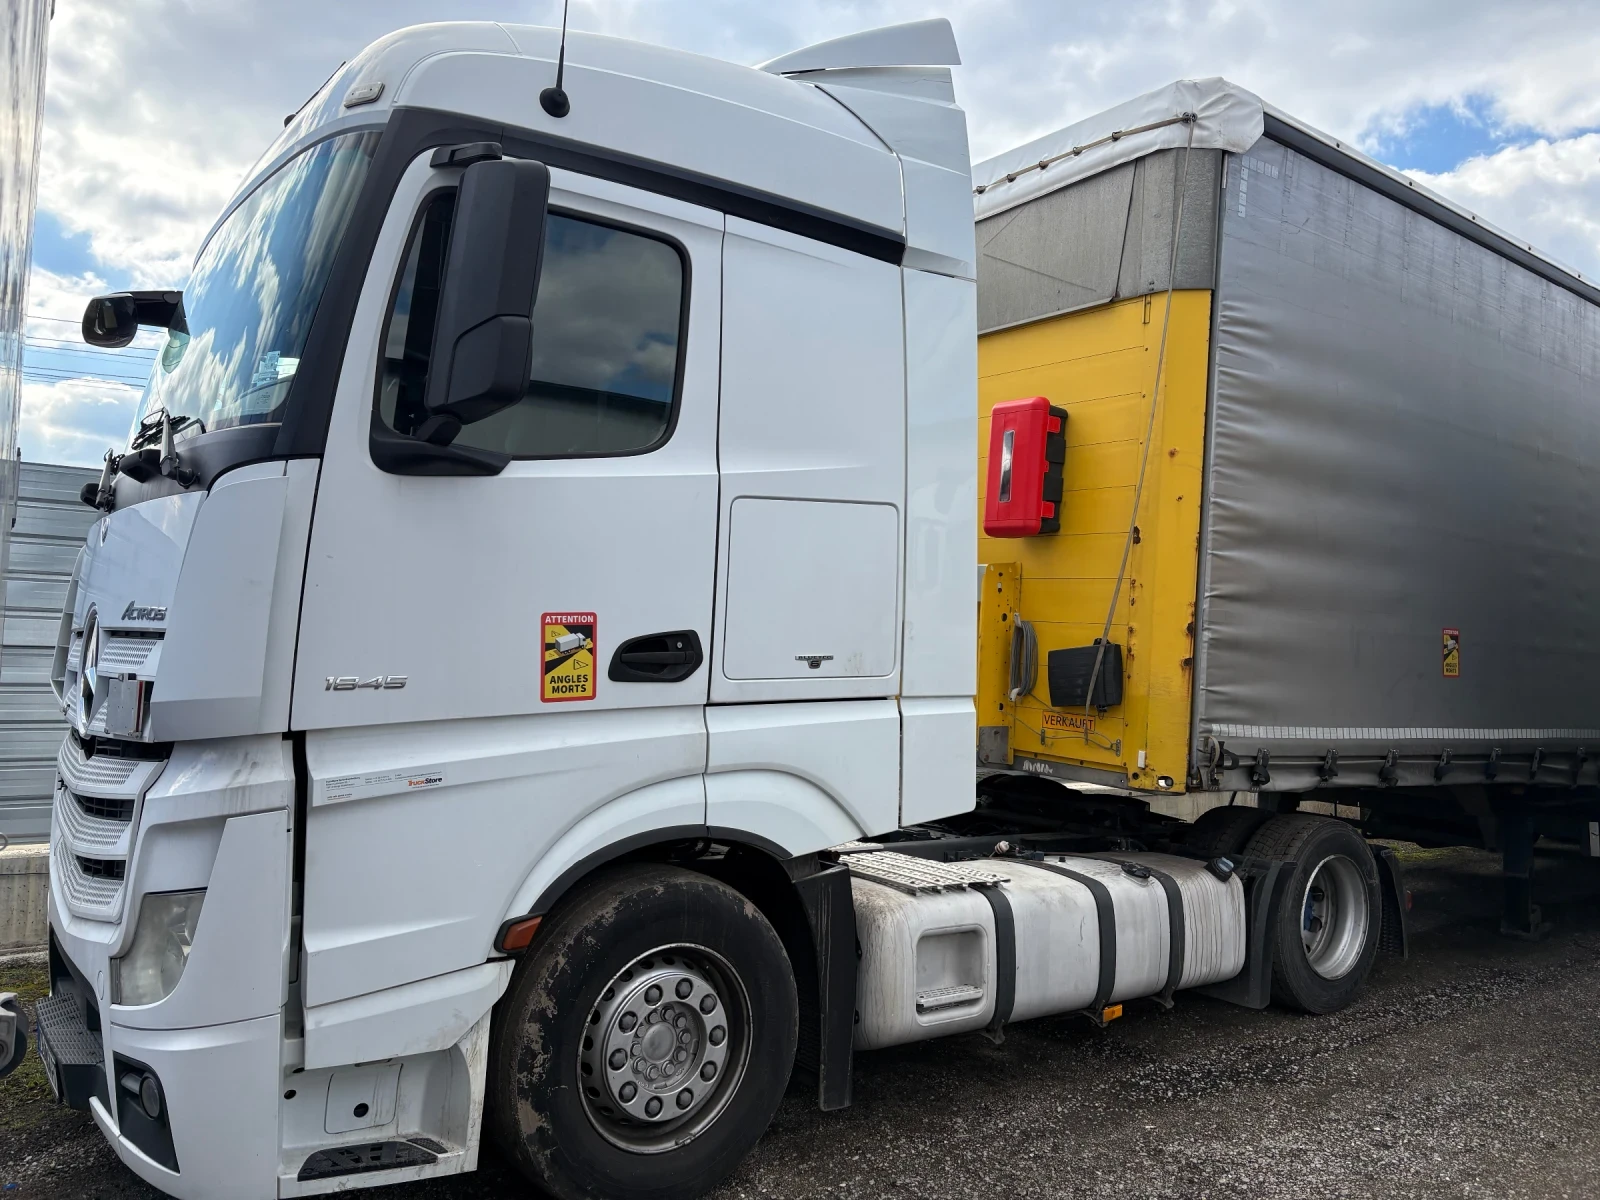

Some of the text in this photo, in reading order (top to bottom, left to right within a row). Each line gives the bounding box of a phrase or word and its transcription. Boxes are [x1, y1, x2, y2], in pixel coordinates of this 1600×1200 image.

[545, 615, 594, 623] ATTENTION
[325, 675, 408, 691] 1845
[549, 674, 589, 684] ANGLES
[551, 684, 587, 694] MORTS
